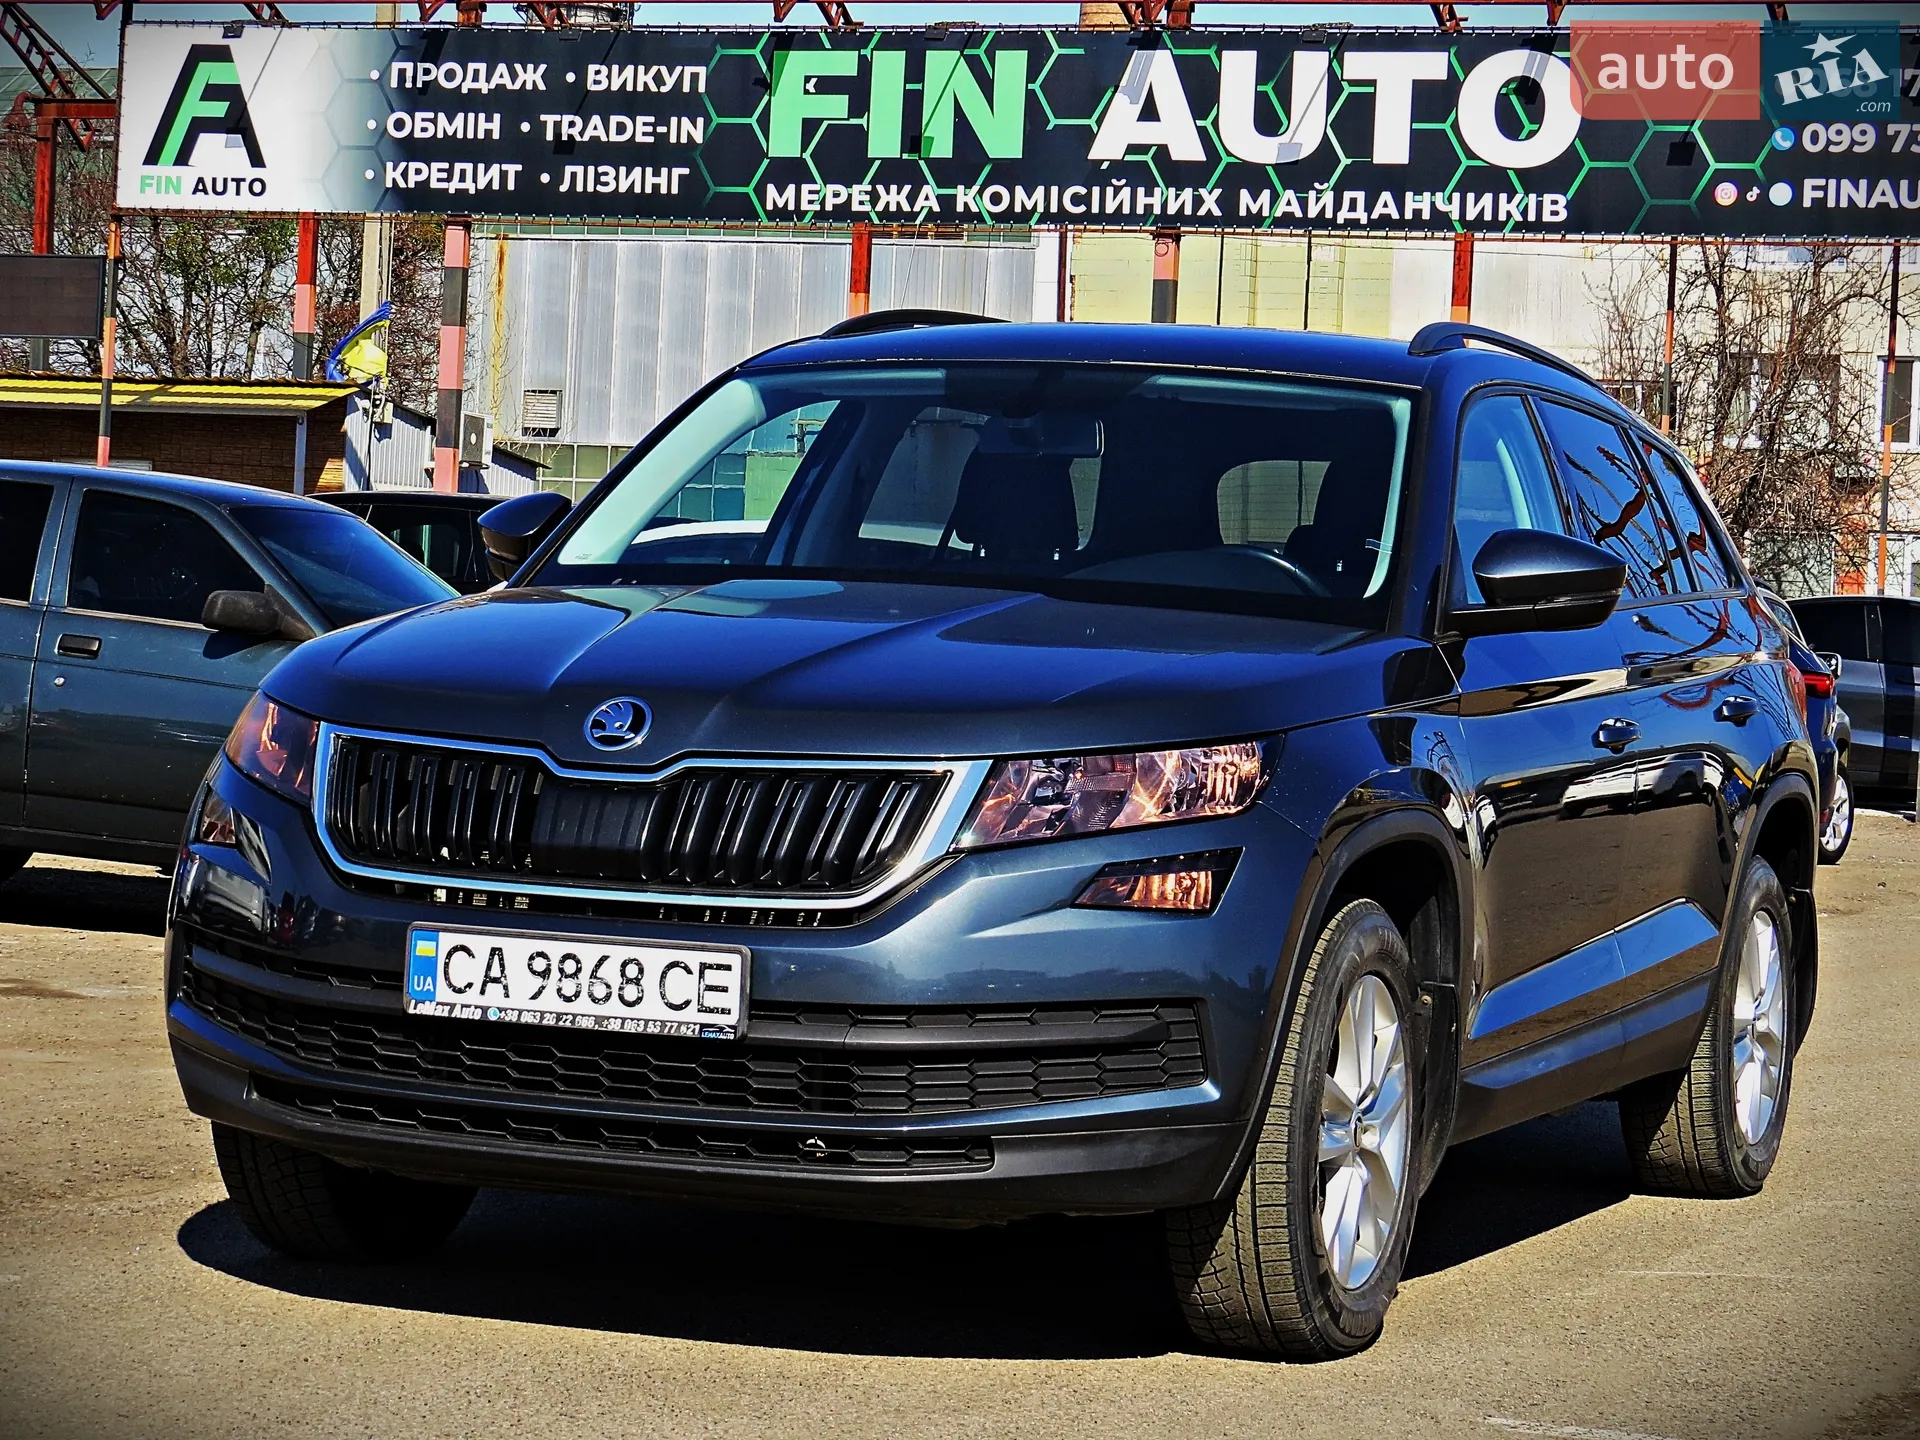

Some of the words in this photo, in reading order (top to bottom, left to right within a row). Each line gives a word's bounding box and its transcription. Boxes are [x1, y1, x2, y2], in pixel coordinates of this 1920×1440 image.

[389, 63, 546, 93] ПРОДАЖ
[587, 64, 708, 93] ВИКУП
[767, 50, 1030, 159] FIN
[1087, 48, 1583, 169] AUTO
[385, 112, 501, 140] ОБМІН
[540, 114, 705, 144] TRADE-IN
[1802, 122, 1877, 153] 099
[139, 175, 182, 195] FIN
[192, 176, 267, 197] AUTO
[385, 161, 524, 194] КРЕДИТ
[558, 164, 691, 196] ЛІЗИНГ
[1802, 178, 1920, 210] FINAU
[765, 184, 938, 213] МЕРЕЖА
[956, 178, 1223, 218] КОМІСІЙНИХ
[1237, 184, 1569, 224] МАЙДАНЧИКІВ
[413, 975, 435, 992] UA
[443, 944, 511, 1000] CA
[527, 950, 645, 1008] 9868
[659, 960, 733, 1016] CE
[408, 1000, 450, 1016] LeMax
[452, 1004, 482, 1020] Auto
[663, 1022, 679, 1034] 77
